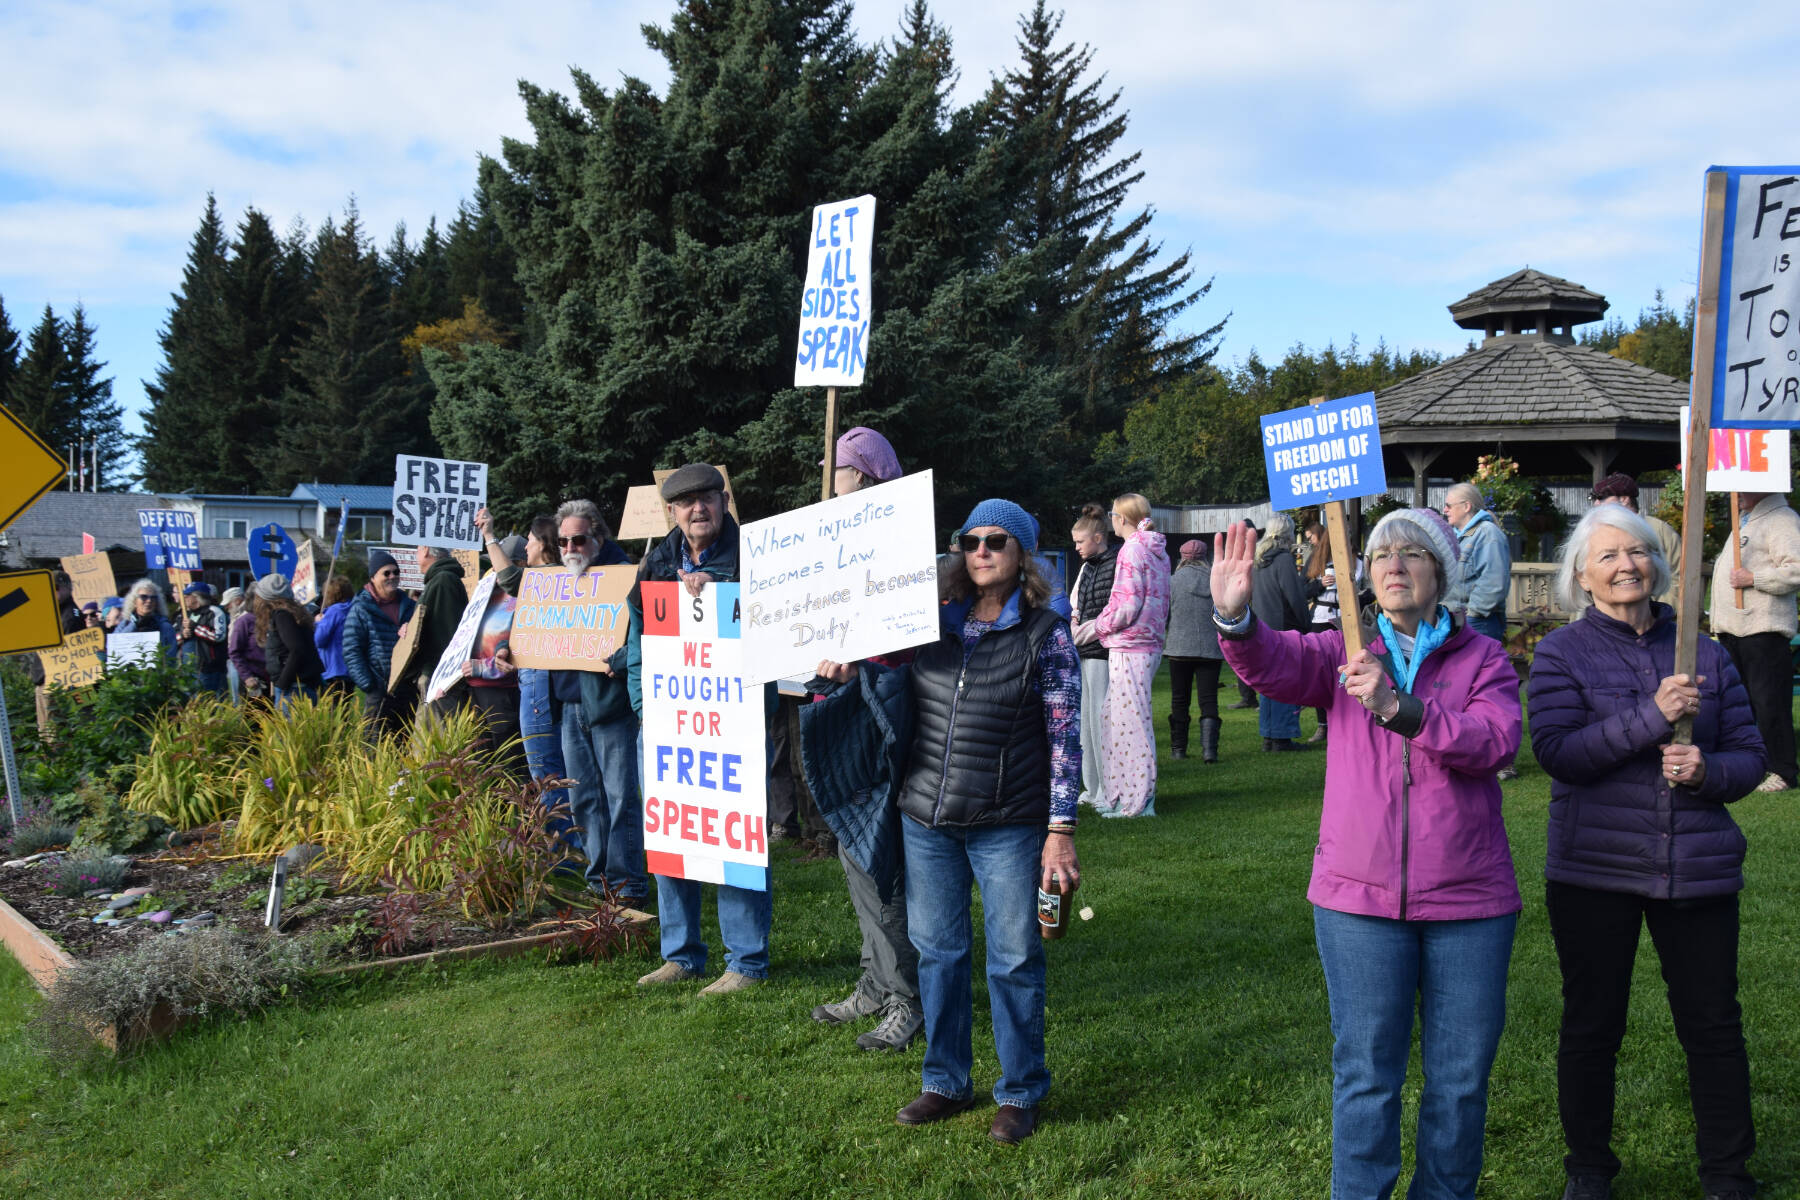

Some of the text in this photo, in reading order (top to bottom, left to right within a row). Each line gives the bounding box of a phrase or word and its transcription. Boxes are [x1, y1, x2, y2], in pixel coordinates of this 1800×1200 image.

[815, 206, 859, 248] LET
[821, 248, 856, 288] ALL
[1773, 253, 1790, 274] IS
[802, 287, 860, 322] SIDES
[798, 320, 868, 377] SPEAK
[1264, 404, 1374, 447] STAND UP FOR
[1273, 433, 1369, 472] FREEDOM OF
[406, 460, 481, 496] FREE
[1290, 463, 1359, 496] SPEECH!
[138, 511, 195, 528] DEFEND
[395, 493, 485, 543] SPEECH
[747, 502, 895, 559] When injustice
[143, 532, 198, 549] THE RULE
[155, 551, 199, 569] OF LAW
[521, 571, 604, 602] PROTECT
[749, 561, 824, 594] becomes
[747, 566, 937, 629] Resistance becomes
[515, 603, 624, 630] COMMUNITY
[51, 645, 99, 665] TO HOLD
[70, 630, 99, 647] CRIME
[511, 632, 615, 660] JOURNALISM
[683, 641, 713, 669] WE
[69, 662, 78, 671] A
[653, 673, 743, 703] FOUGHT
[677, 709, 722, 737] FOR
[656, 745, 742, 793] FREE
[645, 796, 765, 854] SPEECH
